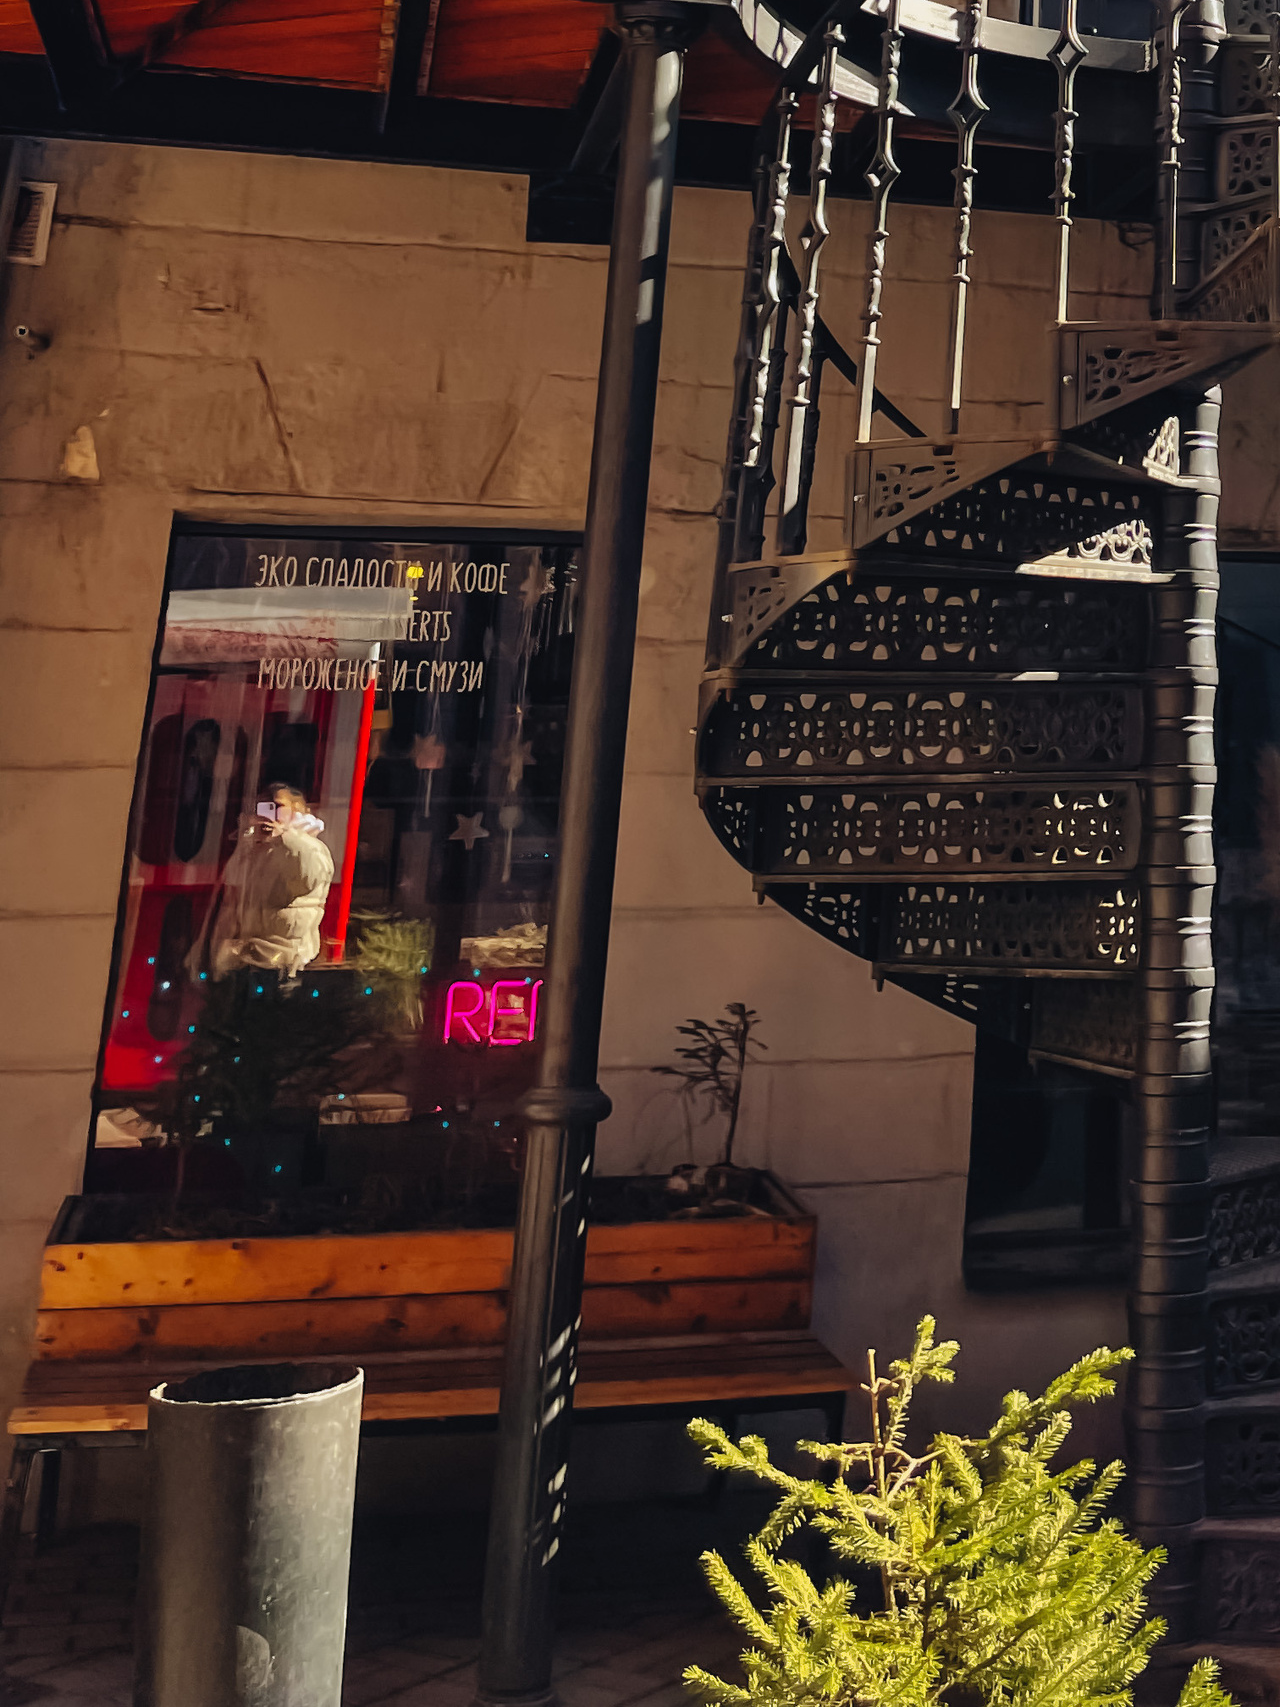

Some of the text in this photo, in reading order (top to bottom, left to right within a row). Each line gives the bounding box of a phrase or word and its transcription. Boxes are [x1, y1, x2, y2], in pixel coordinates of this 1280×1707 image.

[255, 554, 511, 595] ЭКО СЛАДОСТИ И КОФЕ
[408, 609, 453, 643] ERTS
[257, 657, 485, 694] МОРОЖЕНОЕ И СМУЗИ
